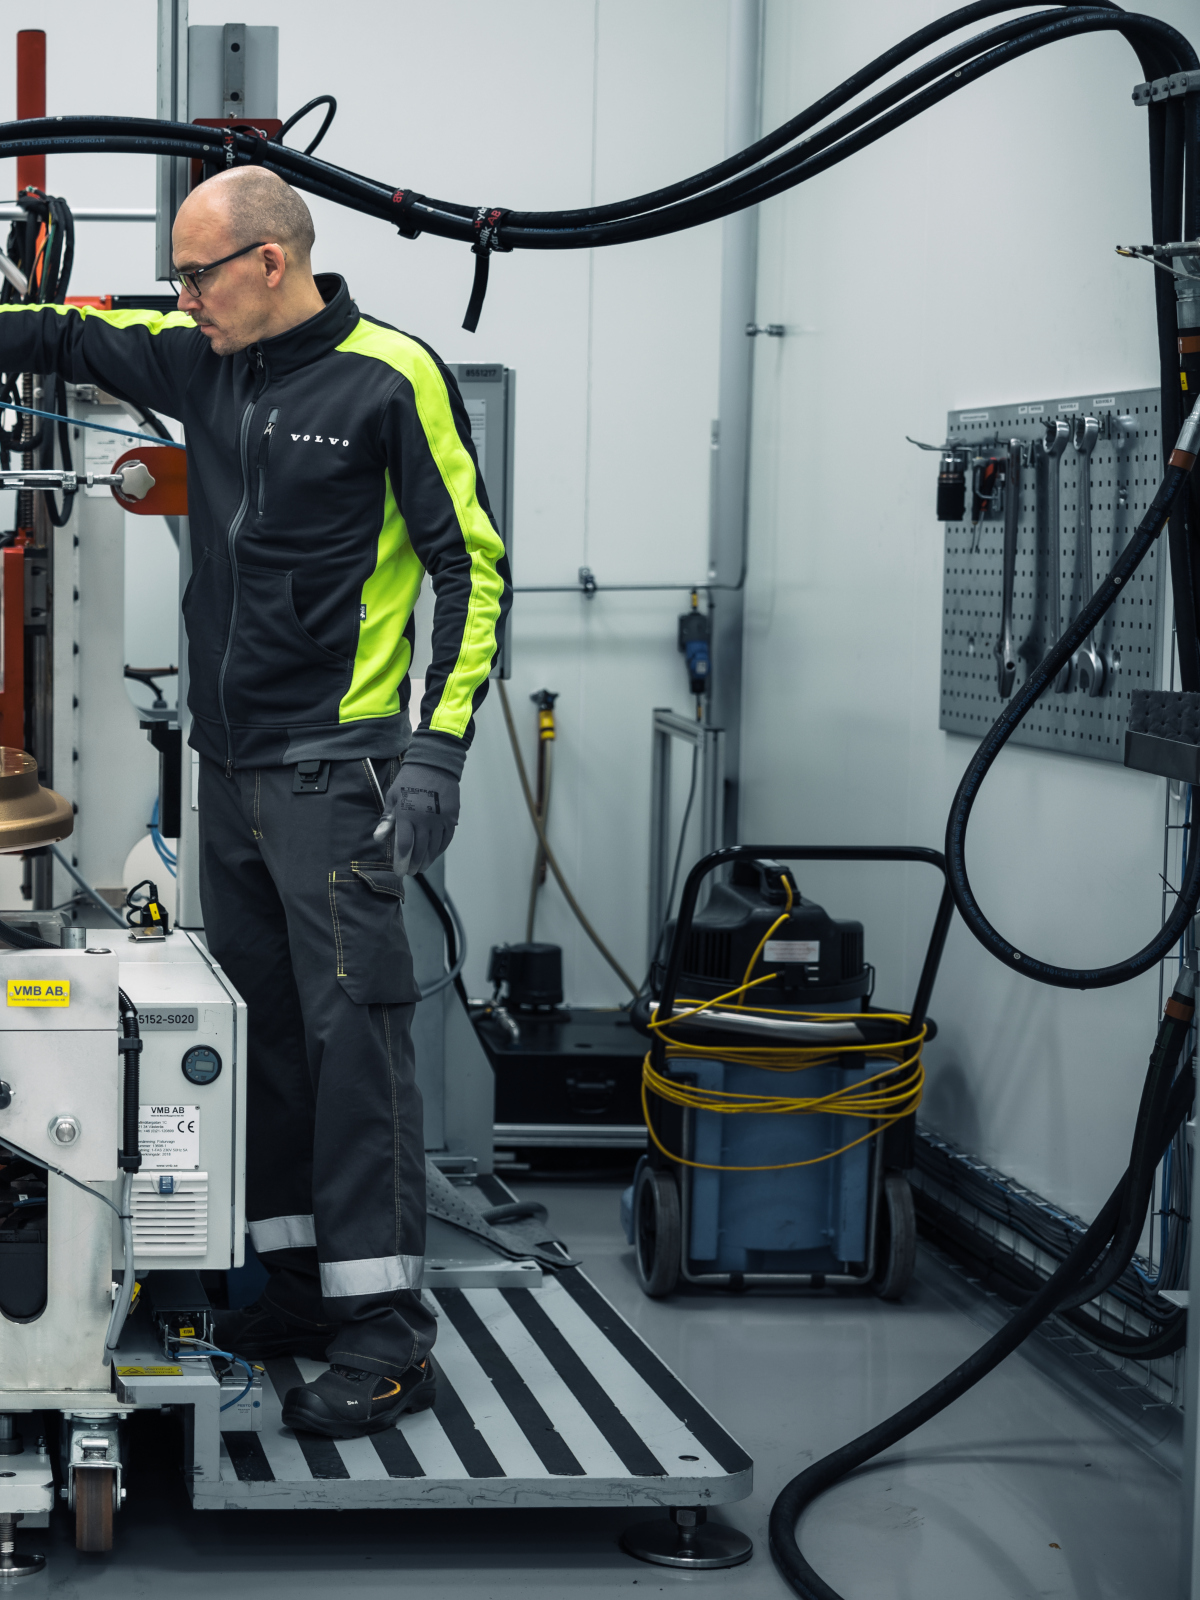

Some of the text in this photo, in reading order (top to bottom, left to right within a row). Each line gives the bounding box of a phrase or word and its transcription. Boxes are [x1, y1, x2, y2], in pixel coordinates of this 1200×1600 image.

[488, 210, 502, 227] AB
[465, 368, 497, 377] 8551217
[290, 433, 350, 447] VOLVO
[1007, 673, 1048, 724] HYDROSCAND
[1130, 932, 1174, 969] HYDROSCAND
[14, 986, 63, 996] VMB AB
[119, 1014, 195, 1024] 85152-S020
